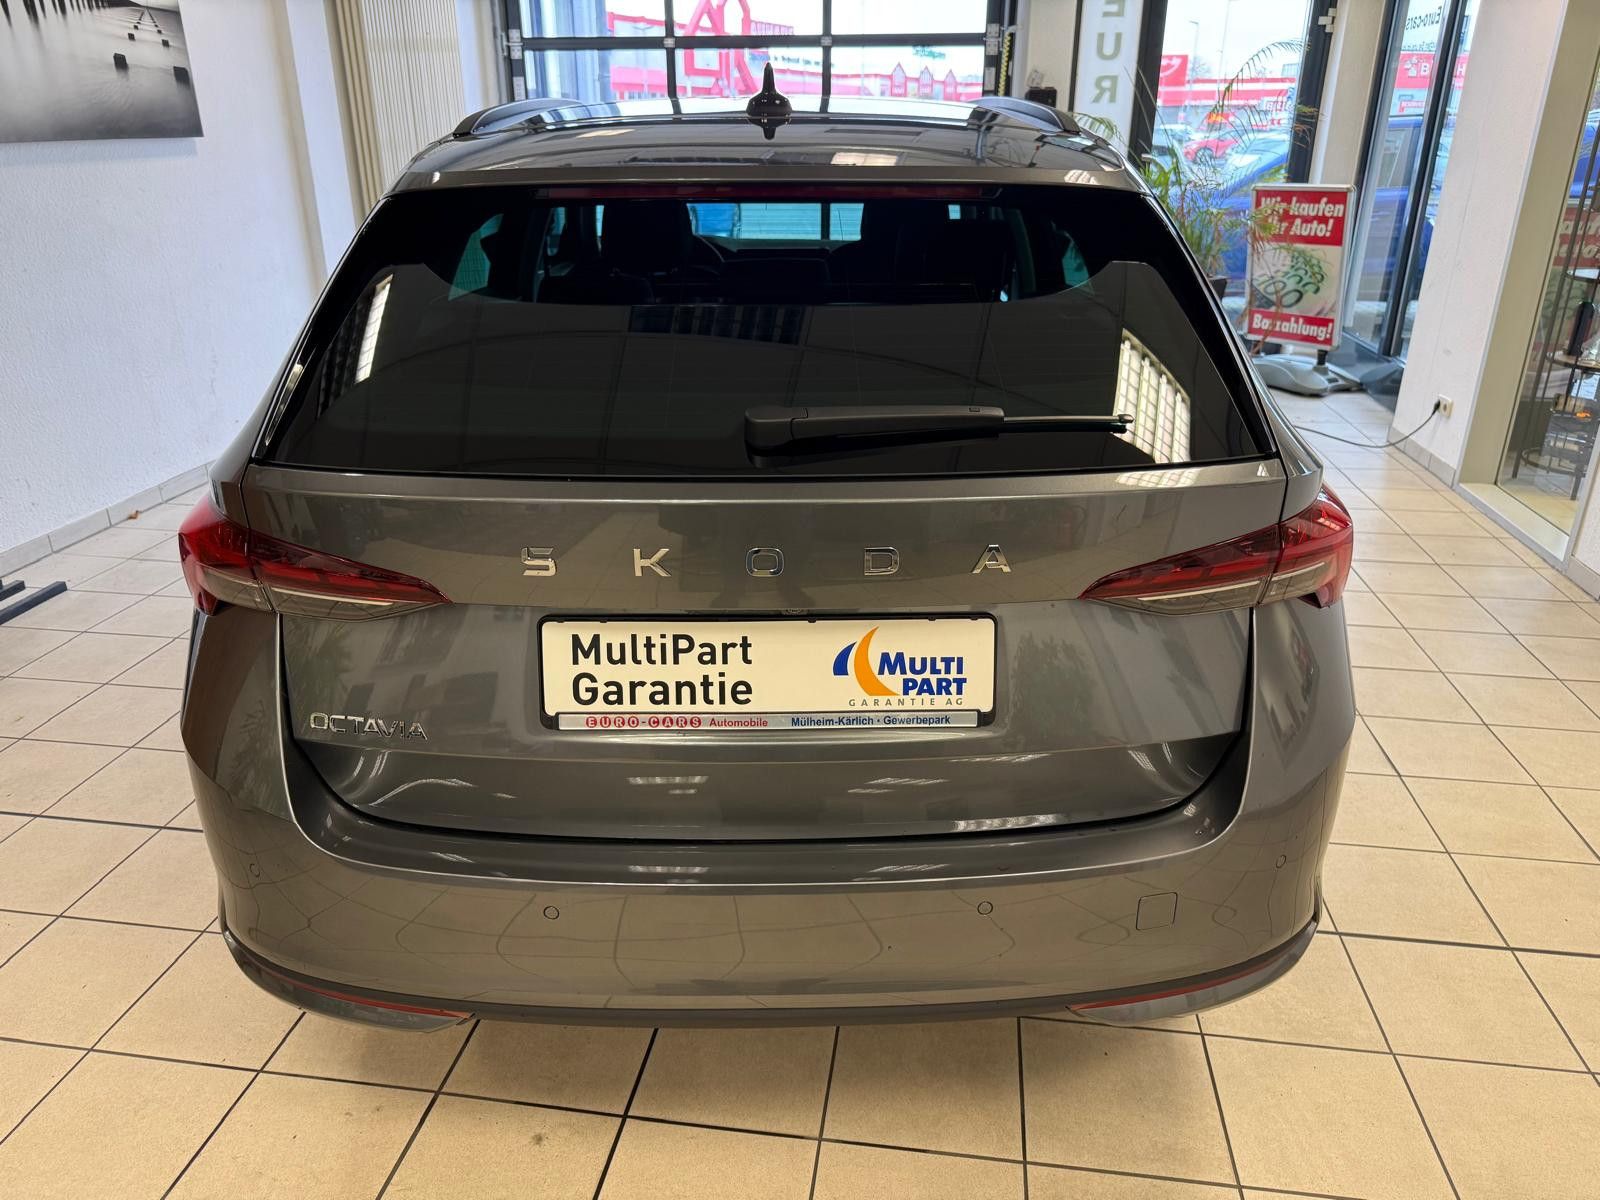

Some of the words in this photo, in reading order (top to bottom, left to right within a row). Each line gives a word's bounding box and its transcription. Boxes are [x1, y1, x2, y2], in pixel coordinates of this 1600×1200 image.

[1289, 196, 1344, 217] kaufen
[1289, 218, 1334, 237] Auto!
[1252, 313, 1334, 341] Bazahlung!
[571, 633, 753, 666] MultiPart
[877, 651, 964, 676] MULTI
[572, 672, 753, 706] Garantie
[902, 677, 967, 696] PART
[848, 698, 936, 707] GARANTIE
[945, 697, 963, 706] AG
[309, 711, 428, 741] OCTAVIA
[585, 715, 702, 729] EURO-CARS
[709, 717, 768, 728] Automobile
[791, 715, 874, 728] Mülheim-Kärlich
[883, 715, 951, 728] Gewerbepark
